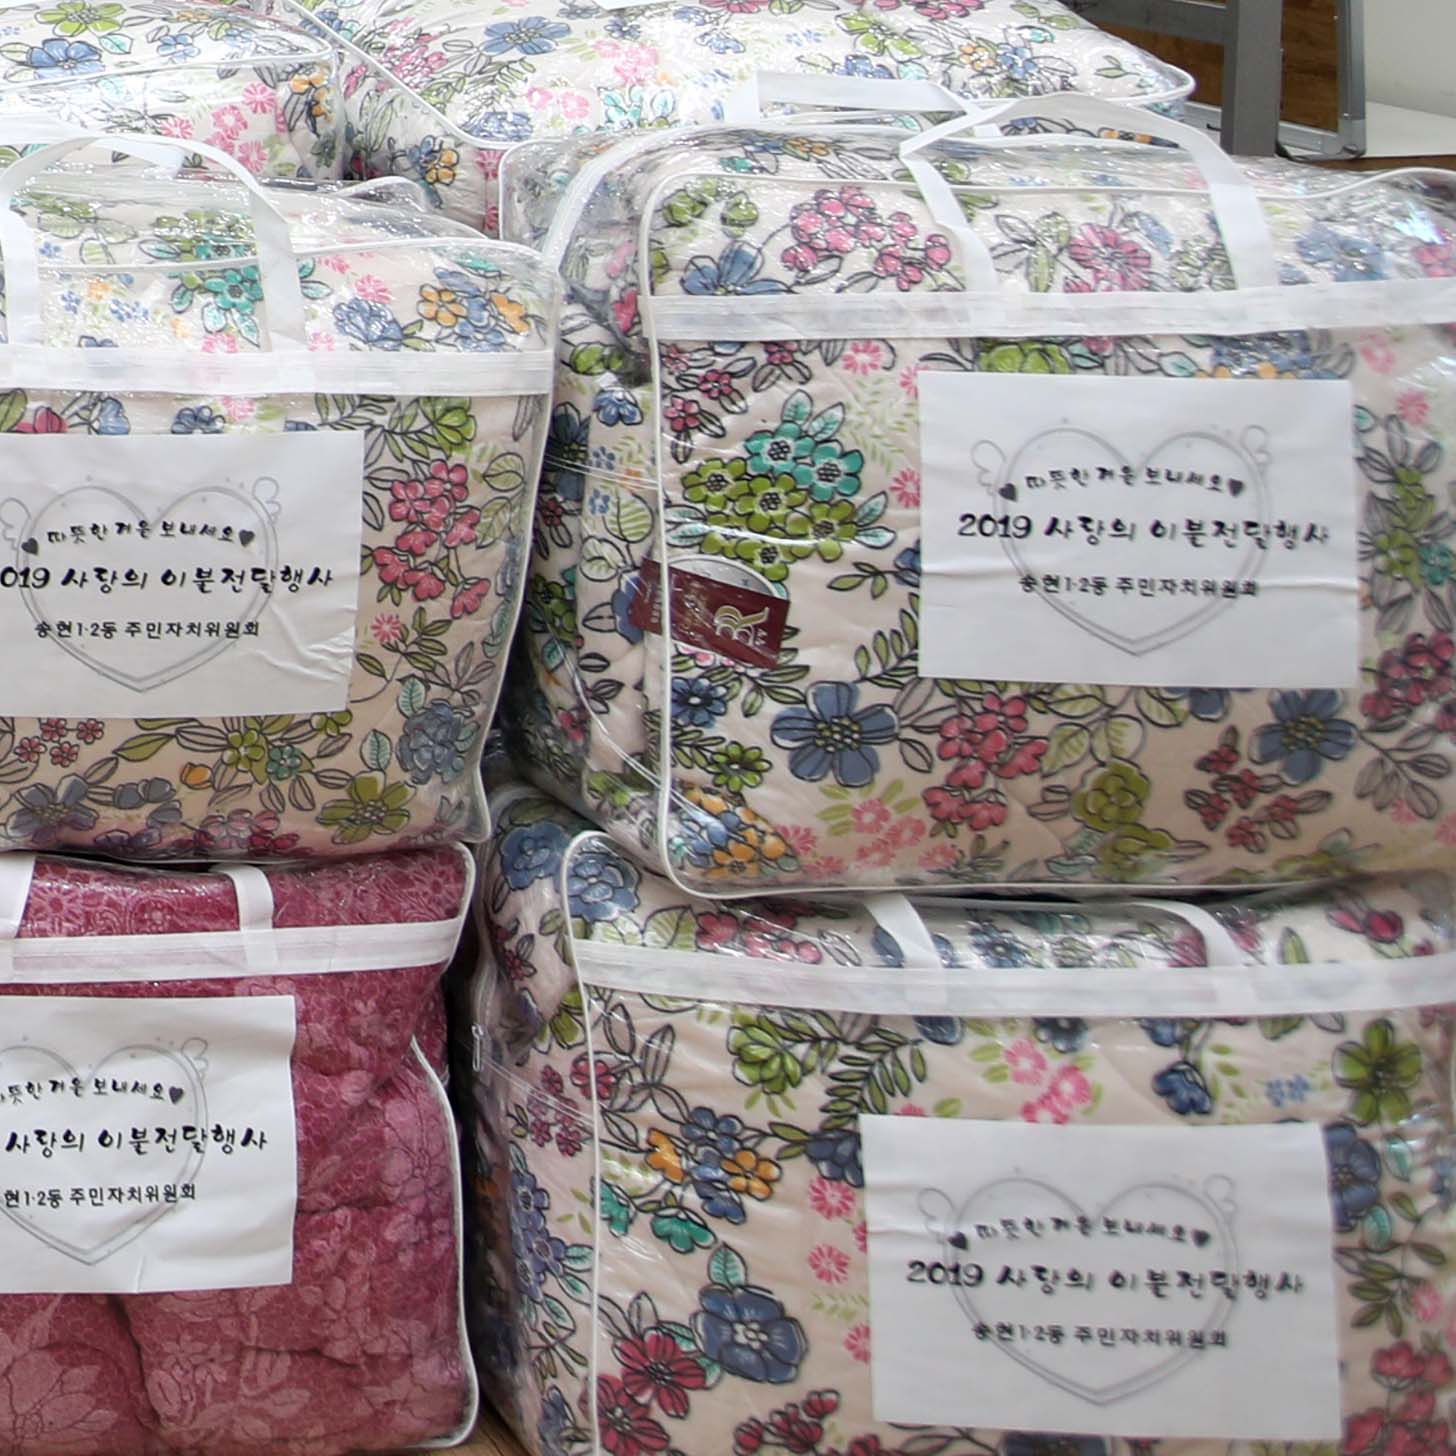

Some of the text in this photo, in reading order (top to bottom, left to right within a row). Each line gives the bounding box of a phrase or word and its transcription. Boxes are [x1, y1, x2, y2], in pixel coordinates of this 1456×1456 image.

[47, 523, 107, 543] 따뜻한
[161, 520, 233, 542] 보내세요
[958, 513, 1033, 540] 2019
[1044, 515, 1135, 546] 사랑의
[60, 567, 148, 594] 사랑의
[160, 565, 333, 595] 이불전달행사
[35, 620, 259, 640] 송현1·2동 주민자치위원회
[94, 1078, 163, 1100] 보내세요
[5, 1130, 85, 1159] 사랑의
[97, 1125, 267, 1156] 이불전달행사
[70, 1183, 195, 1207] 주민자치위원회
[907, 1260, 985, 1288] 2019
[996, 1265, 1093, 1295] 사랑의
